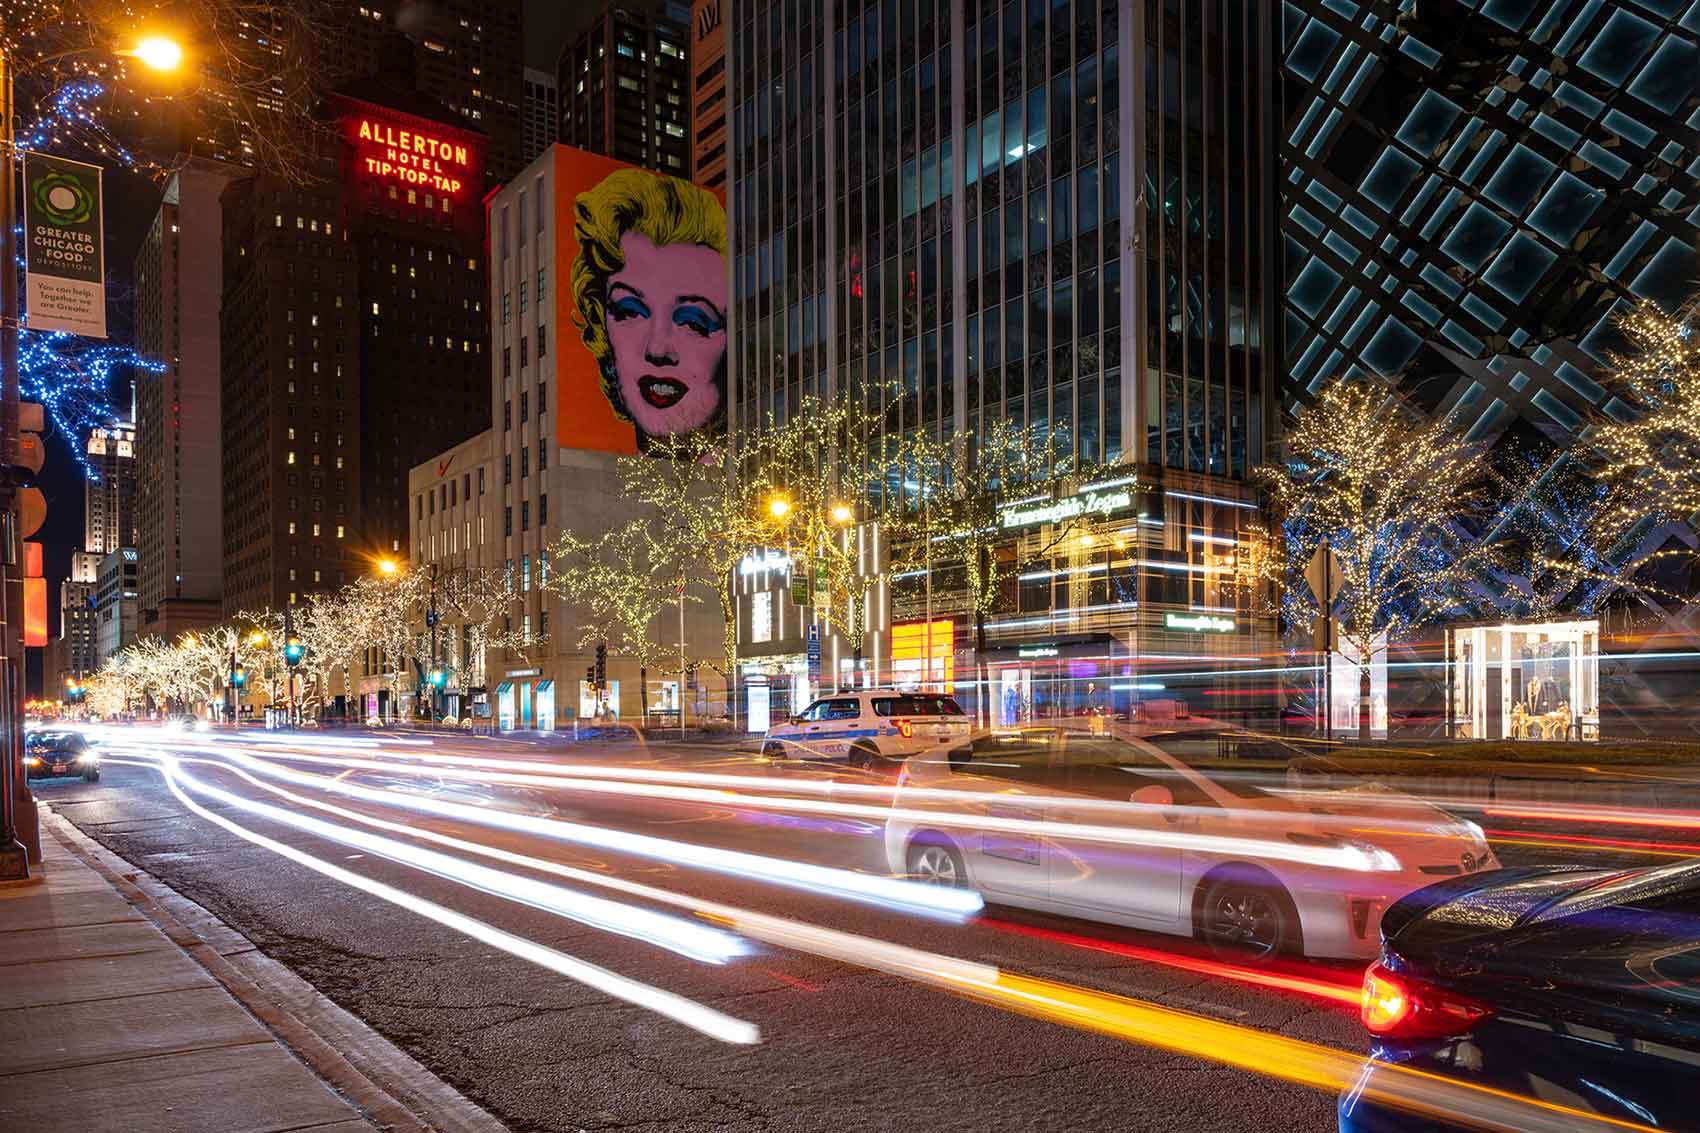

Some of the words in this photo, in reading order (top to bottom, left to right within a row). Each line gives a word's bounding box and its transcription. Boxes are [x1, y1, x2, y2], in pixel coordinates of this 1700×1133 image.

[359, 120, 467, 166] ALLERTON
[387, 149, 443, 173] HOTEL
[36, 226, 92, 243] GREATER
[34, 237, 95, 254] CHICAGO
[46, 249, 84, 262] FOOD
